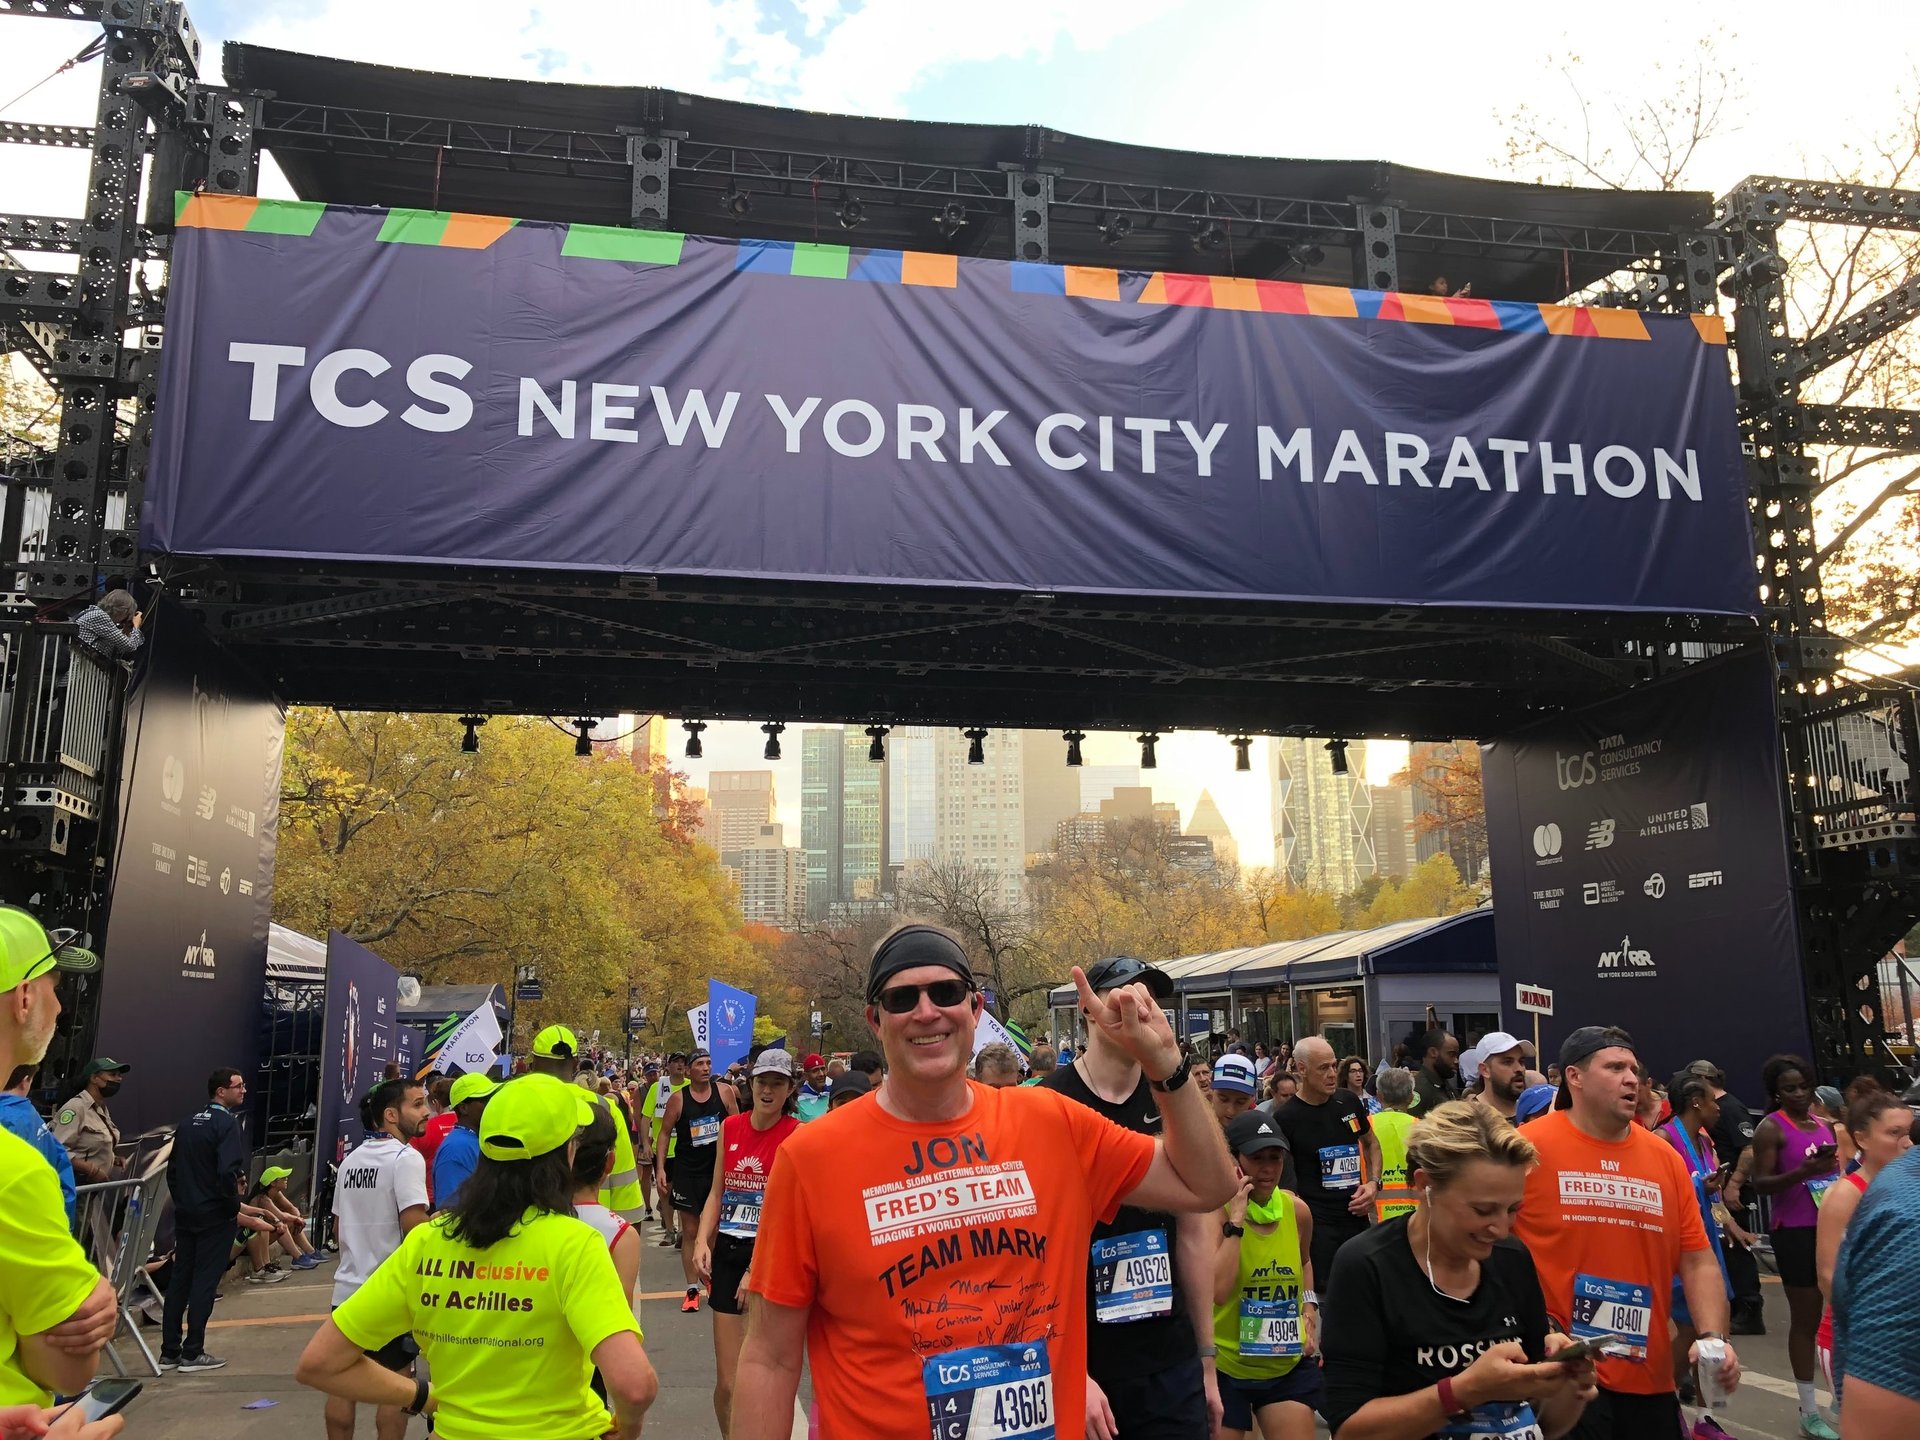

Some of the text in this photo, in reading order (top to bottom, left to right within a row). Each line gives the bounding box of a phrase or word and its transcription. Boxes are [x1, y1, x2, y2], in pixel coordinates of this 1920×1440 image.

[228, 342, 1704, 502] TCS NEW YORK CITY MARATHON
[1599, 734, 1625, 750] TATA
[1600, 739, 1662, 765] CONSULTANCY
[1556, 750, 1597, 790] tcs
[1601, 762, 1641, 781] SERVICES
[1648, 809, 1688, 824] UNITED
[1640, 820, 1689, 837] AIRLINES
[1688, 870, 1723, 889] ESPN
[1533, 890, 1545, 900] THE
[1601, 890, 1625, 898] MARATHON
[1540, 900, 1560, 910] FAMILY
[697, 1010, 707, 1042] 2022
[988, 1019, 1001, 1033] TCS
[1000, 1032, 1015, 1048] NEW
[434, 1014, 480, 1069] CITY MARATHON
[465, 1052, 485, 1064] tcs
[903, 1132, 990, 1175] JON
[1600, 1159, 1620, 1172] RAY
[344, 1168, 379, 1189] CHORRI
[725, 1178, 767, 1189] COMMUNIT
[747, 1174, 768, 1182] SUPPO
[862, 1160, 1024, 1199] MEMORIAL SLOAN KETTERING CANCER CENTER
[875, 1178, 1025, 1222] FRED'S TEAM
[1565, 1180, 1658, 1203] FRED'S TEAM
[1560, 1198, 1587, 1206] IMAGINE
[1594, 1200, 1614, 1208] WORLD
[1615, 1202, 1643, 1212] WITHOUT
[741, 1206, 761, 1223] 478
[1607, 1217, 1617, 1225] MY
[871, 1205, 1038, 1247] IMAGINE A WORLD WITHOUT CANCER
[1101, 1246, 1117, 1259] tcs
[416, 1257, 549, 1281] ALL INclusive
[878, 1227, 1047, 1299] TEAM MARK
[1102, 1266, 1109, 1275] 4
[1126, 1256, 1169, 1287] 49628
[1103, 1281, 1109, 1290] F
[1242, 1285, 1299, 1303] TEAM
[1584, 1281, 1603, 1296] tcs
[421, 1290, 533, 1312] or Achilles
[1247, 1304, 1263, 1314] tcs
[1583, 1300, 1591, 1309] 2
[1582, 1312, 1590, 1322] C
[1611, 1305, 1643, 1332] 18401
[971, 1356, 989, 1365] TATA
[1417, 1336, 1523, 1368] ROSS
[938, 1364, 971, 1385] tcs
[972, 1360, 1011, 1372] CONSULTANCY
[973, 1369, 1000, 1380] SERVICES
[1020, 1362, 1041, 1371] TATA
[945, 1397, 958, 1413] 4
[993, 1381, 1048, 1432] 43613
[948, 1422, 962, 1439] C
